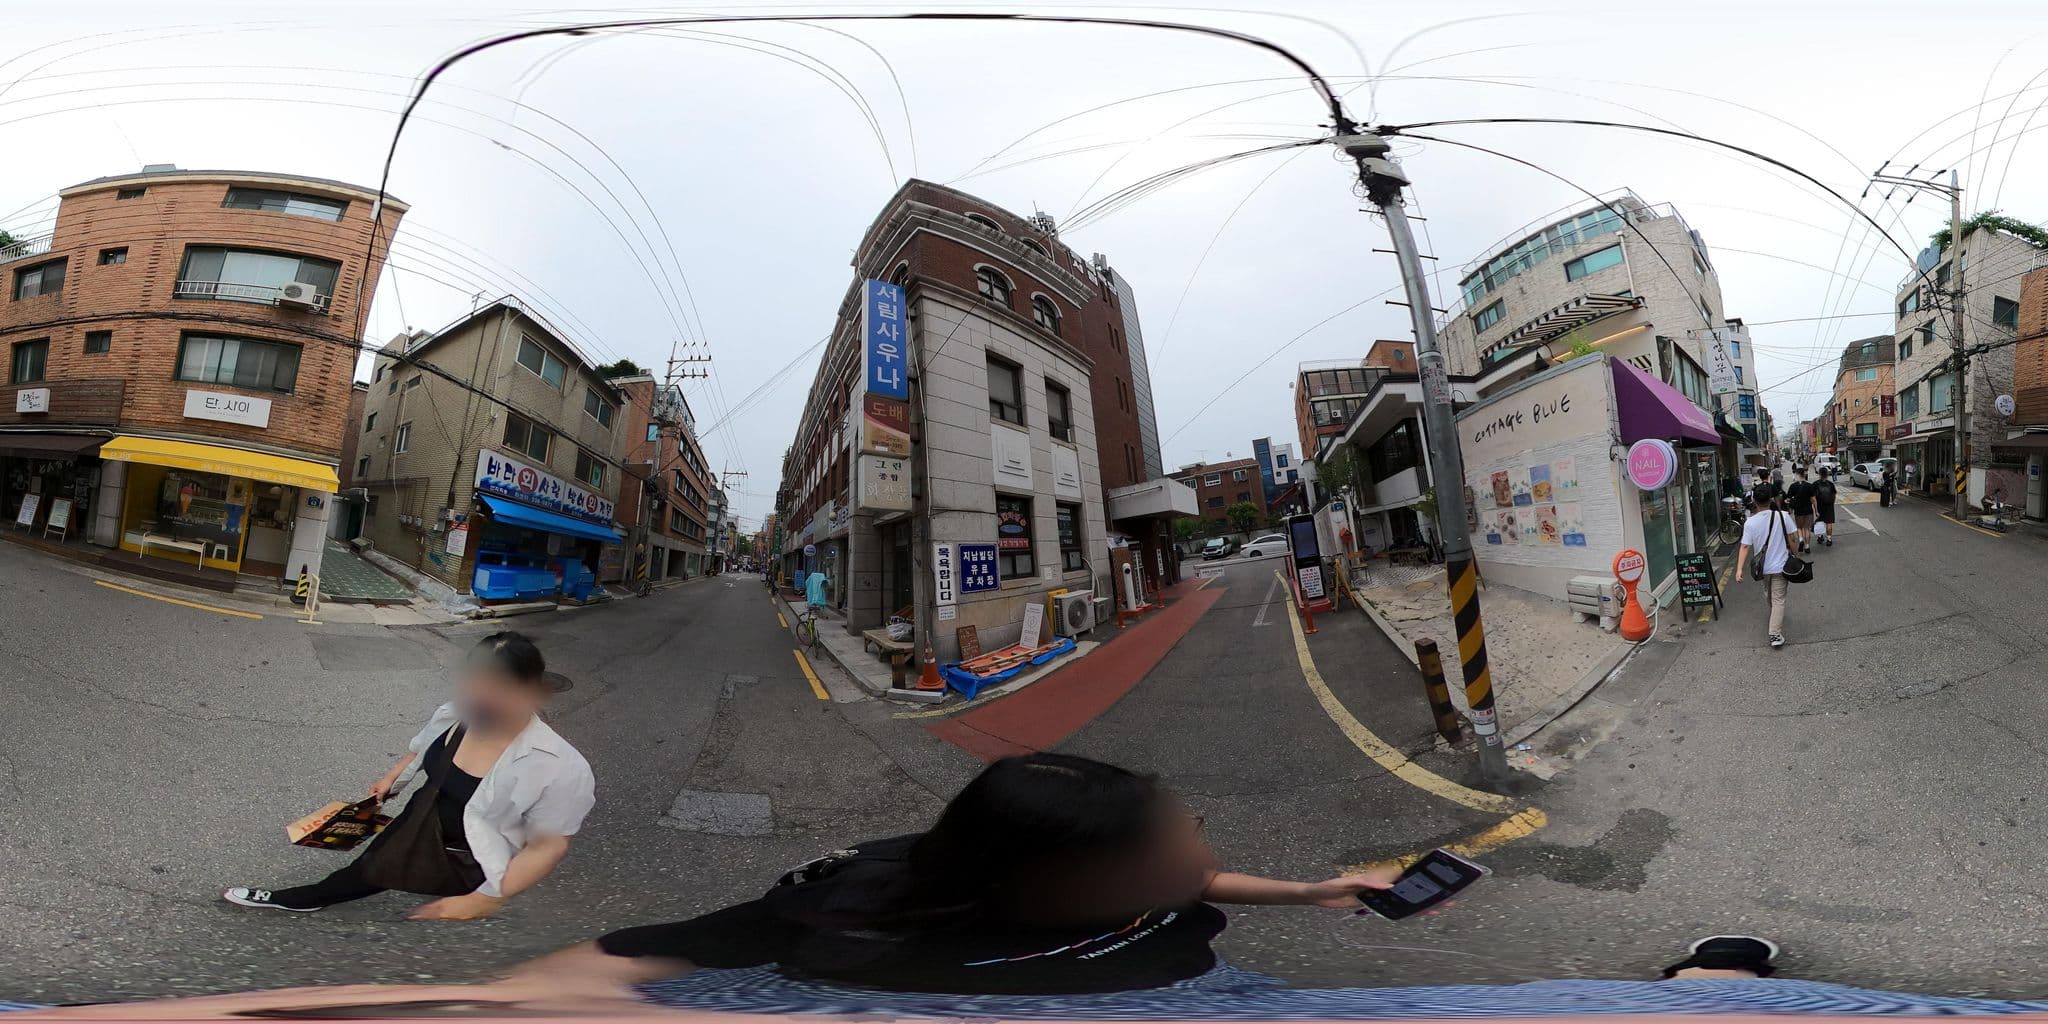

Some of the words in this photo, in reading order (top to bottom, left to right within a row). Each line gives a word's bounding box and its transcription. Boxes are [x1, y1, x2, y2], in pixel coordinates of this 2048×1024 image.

[877, 286, 900, 390] 서림사우나
[872, 402, 903, 422] 도배
[1475, 410, 1523, 443] COTTAGE
[1533, 394, 1571, 424] BLUE
[874, 460, 902, 471] 그린
[1635, 458, 1661, 471] NAIL
[963, 550, 994, 562] 지남빌딩
[938, 547, 952, 601] 목욕합니다
[970, 564, 988, 575] 유료
[966, 575, 994, 588] 주차장
